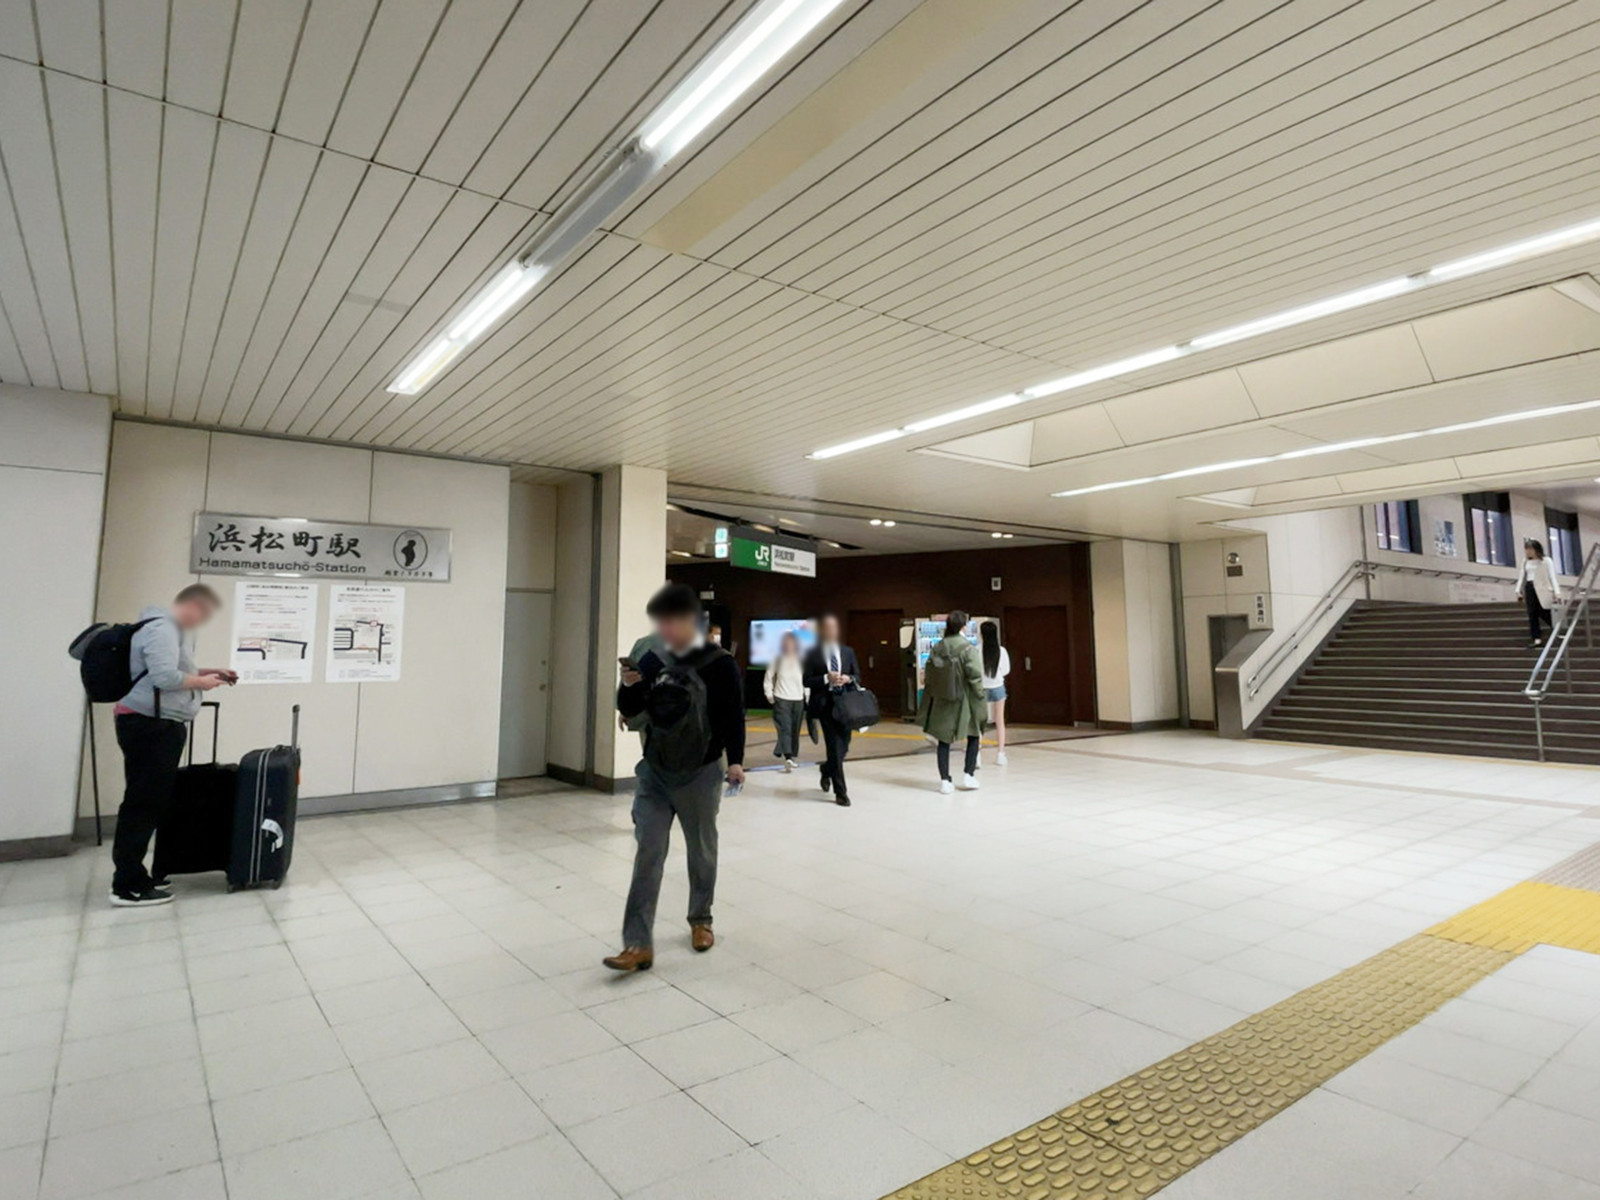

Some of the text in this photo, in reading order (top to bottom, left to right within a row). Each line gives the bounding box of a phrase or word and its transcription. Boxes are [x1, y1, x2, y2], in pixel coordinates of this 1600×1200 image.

[208, 523, 361, 559] 浜松町駅
[755, 545, 769, 562] JR
